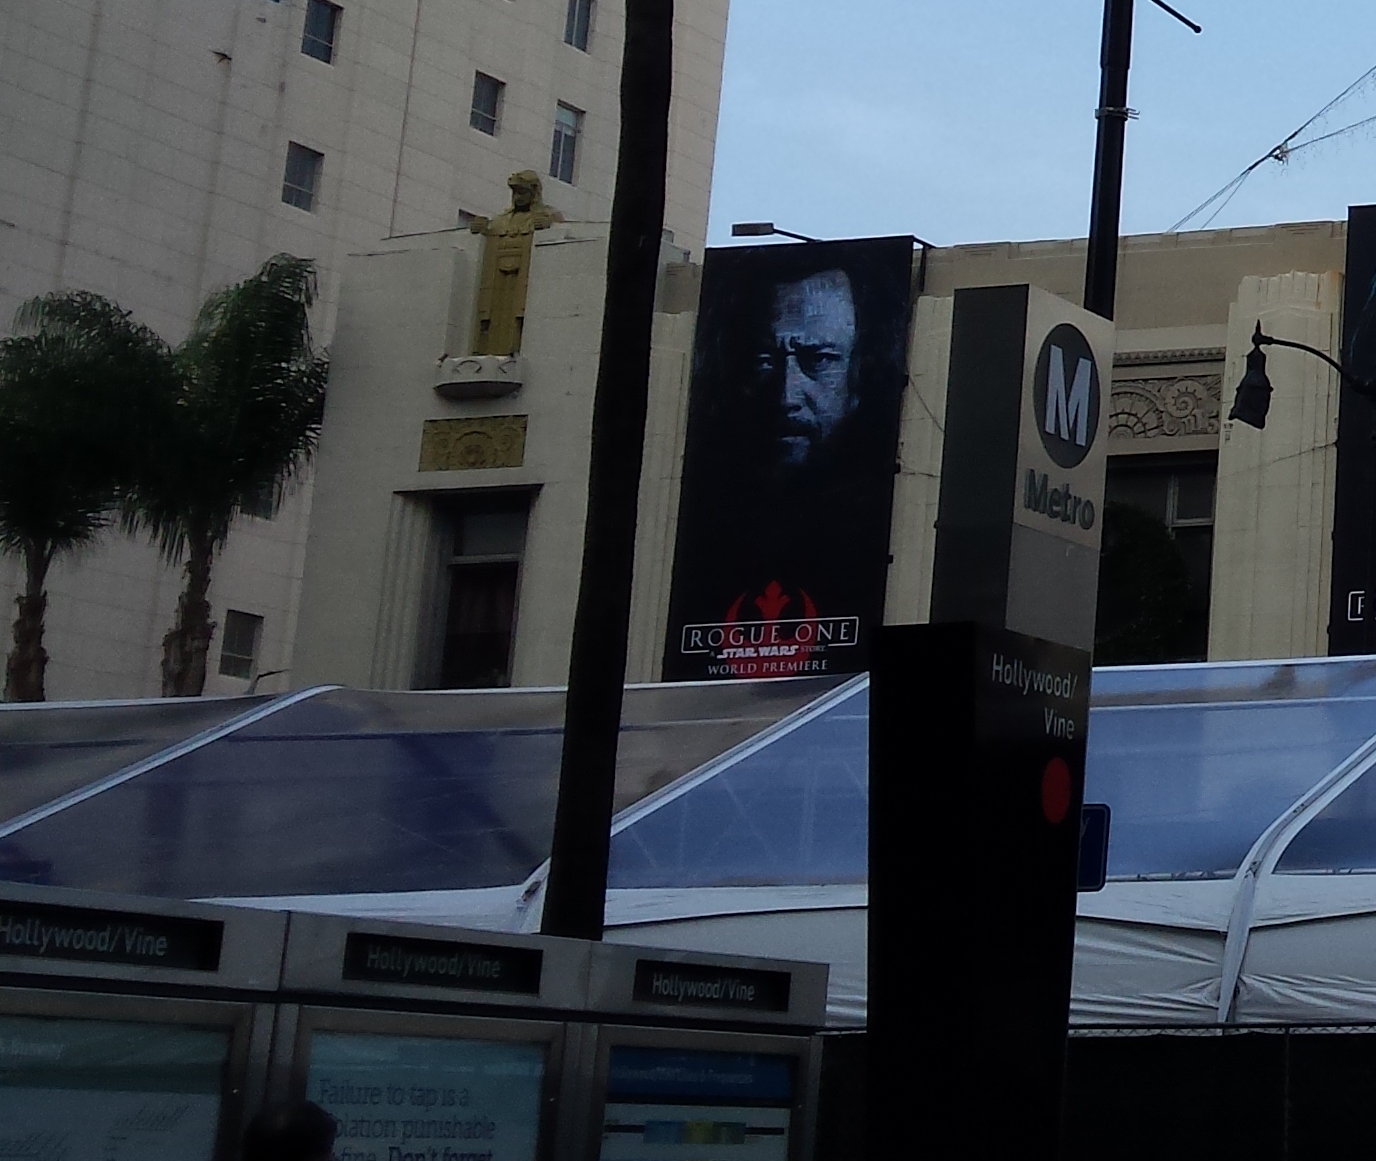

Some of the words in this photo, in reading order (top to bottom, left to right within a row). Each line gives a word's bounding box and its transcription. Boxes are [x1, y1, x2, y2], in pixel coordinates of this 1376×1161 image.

[1044, 344, 1093, 448] M
[1023, 467, 1095, 531] Metro
[690, 625, 781, 648] ROGUE
[795, 621, 851, 643] ONE
[716, 647, 757, 659] STAR
[758, 644, 800, 658] WARS
[707, 662, 758, 676] WORLD
[762, 659, 829, 674] PREMIERE
[992, 652, 1078, 700] Hollywood/
[1044, 706, 1075, 740] Vine
[319, 1078, 382, 1105] Failure
[387, 1083, 405, 1106] to
[409, 1084, 437, 1113] tap
[458, 1088, 470, 1107] a
[334, 1114, 396, 1138] olation
[402, 1115, 496, 1145] punishable
